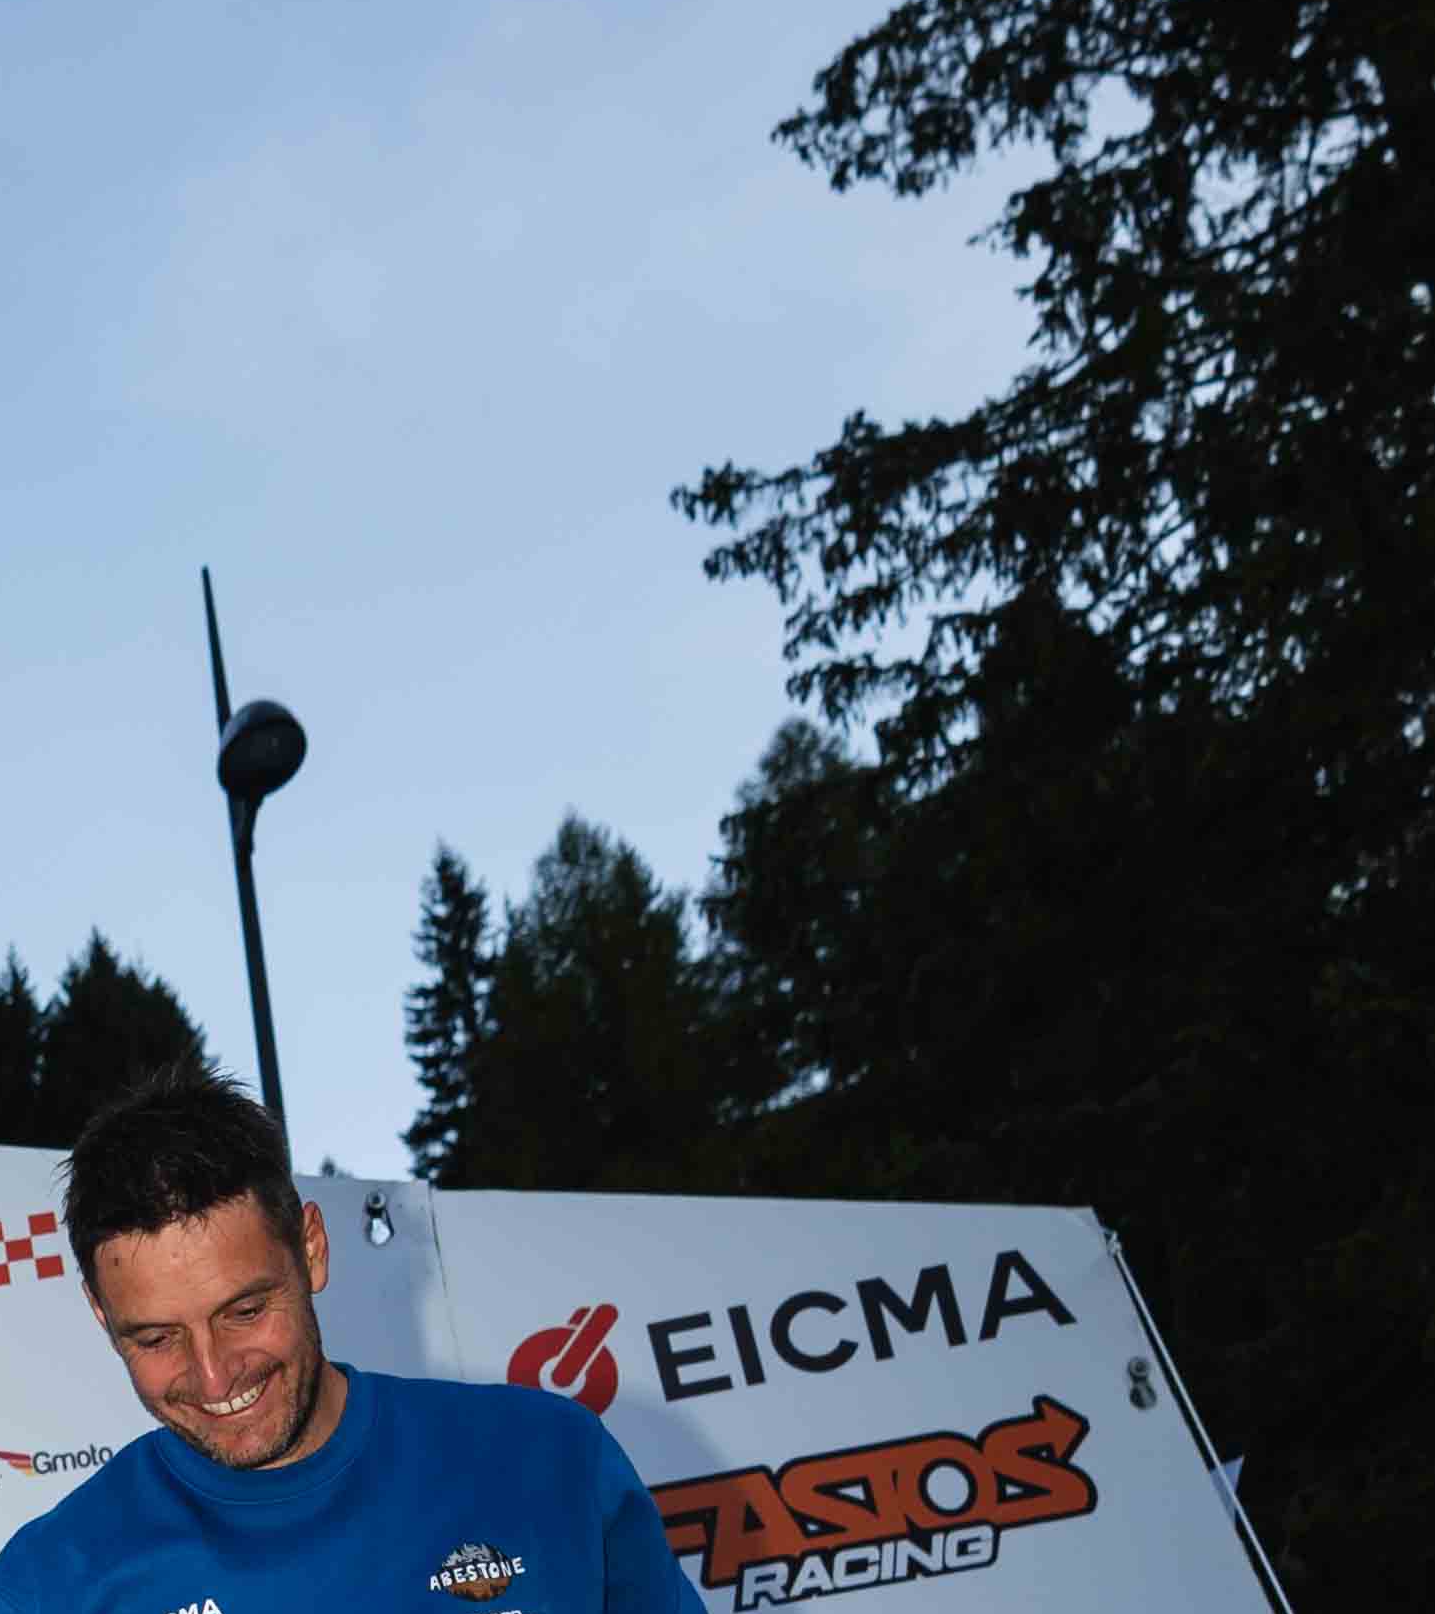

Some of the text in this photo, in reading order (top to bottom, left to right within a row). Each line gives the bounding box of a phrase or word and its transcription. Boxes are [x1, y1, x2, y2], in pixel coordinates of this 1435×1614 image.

[647, 1250, 1077, 1402] EICMA
[429, 1556, 527, 1591] ABESTONE
[733, 1522, 999, 1613] RACING
